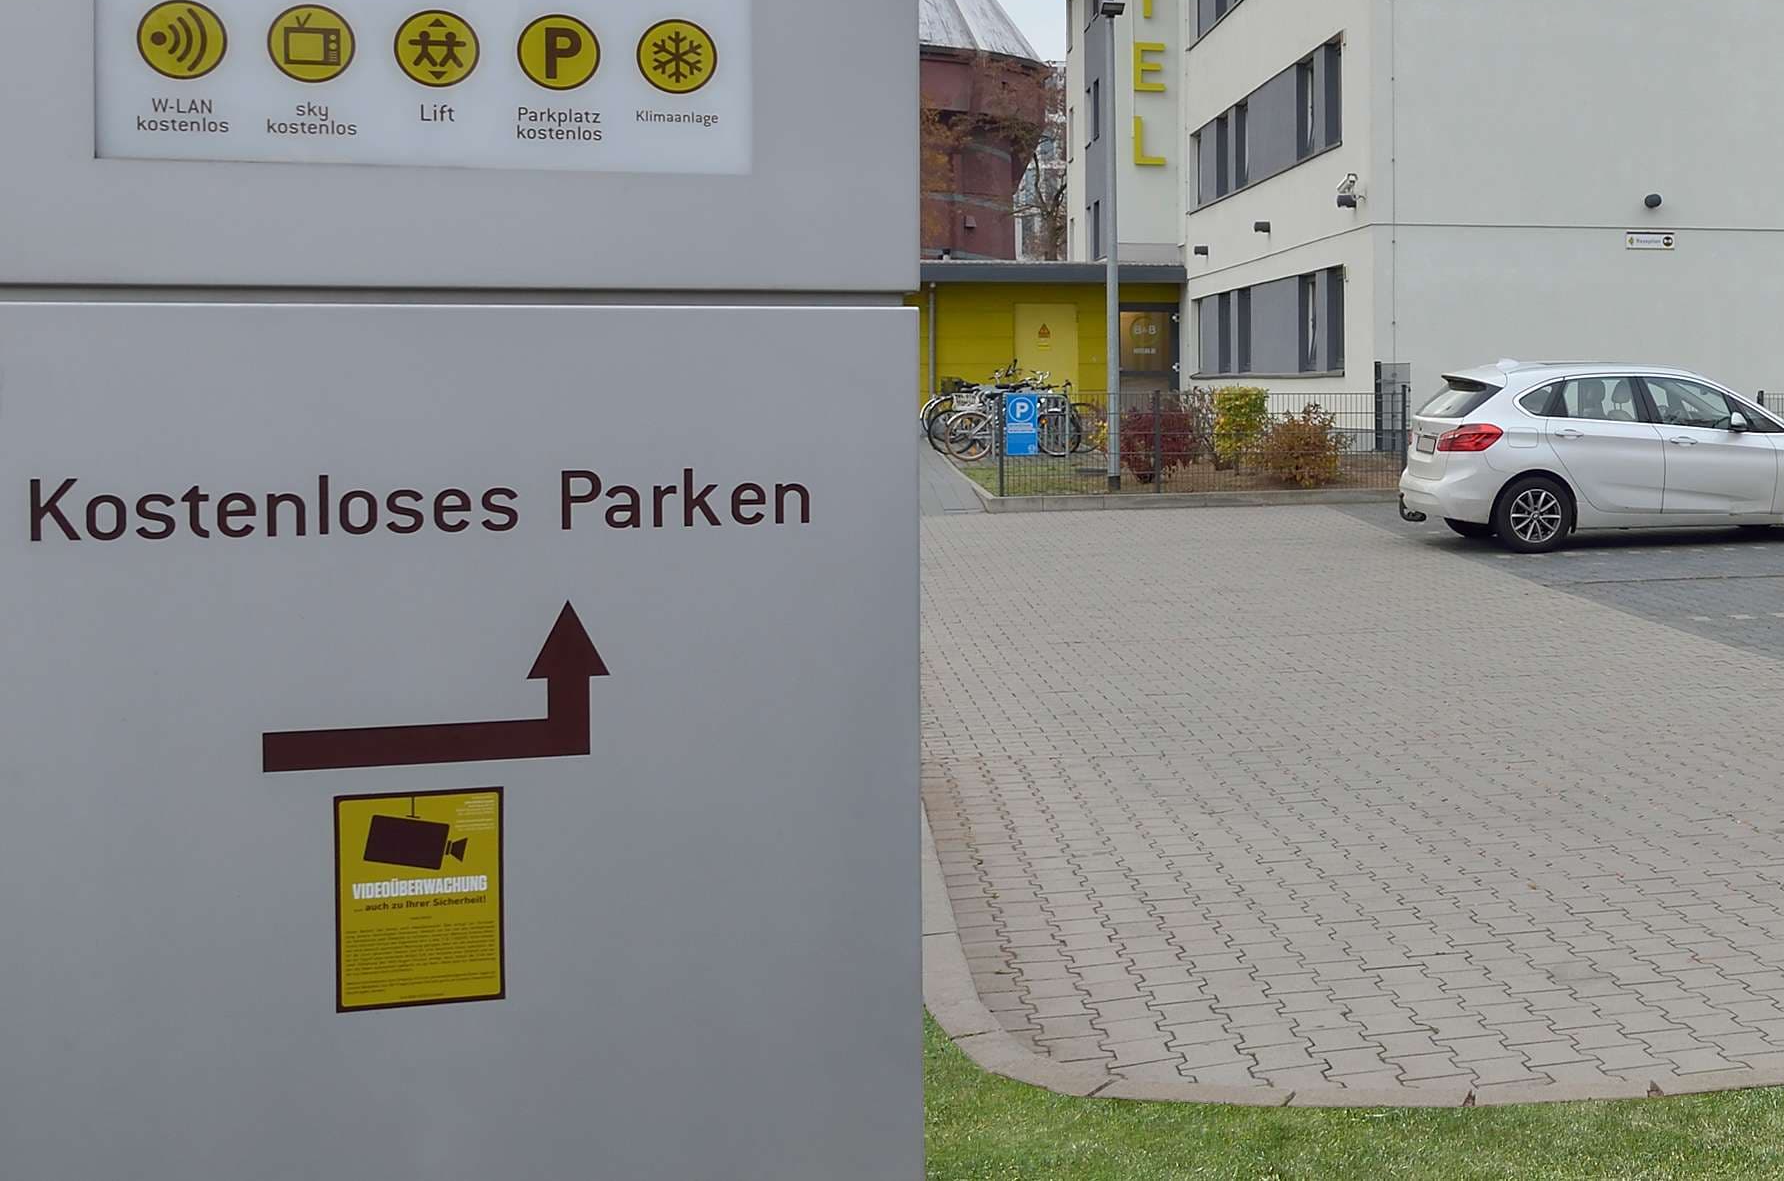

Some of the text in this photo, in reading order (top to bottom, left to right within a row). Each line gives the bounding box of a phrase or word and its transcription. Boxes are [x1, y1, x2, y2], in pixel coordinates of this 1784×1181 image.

[151, 98, 212, 114] W-LAN
[296, 102, 329, 121] sky
[420, 104, 455, 122] Lift
[137, 115, 229, 132] kostenlos
[517, 107, 600, 126] Parkplatz
[635, 110, 719, 127] Klimaanlage
[267, 119, 357, 135] kostenlos
[516, 125, 602, 140] kostenlos
[28, 468, 811, 541] Kostenloses Parken
[352, 875, 488, 900] VIDEOÜBERWACHUNG
[365, 895, 487, 911] auch zu Ihrer Sicherheit!
